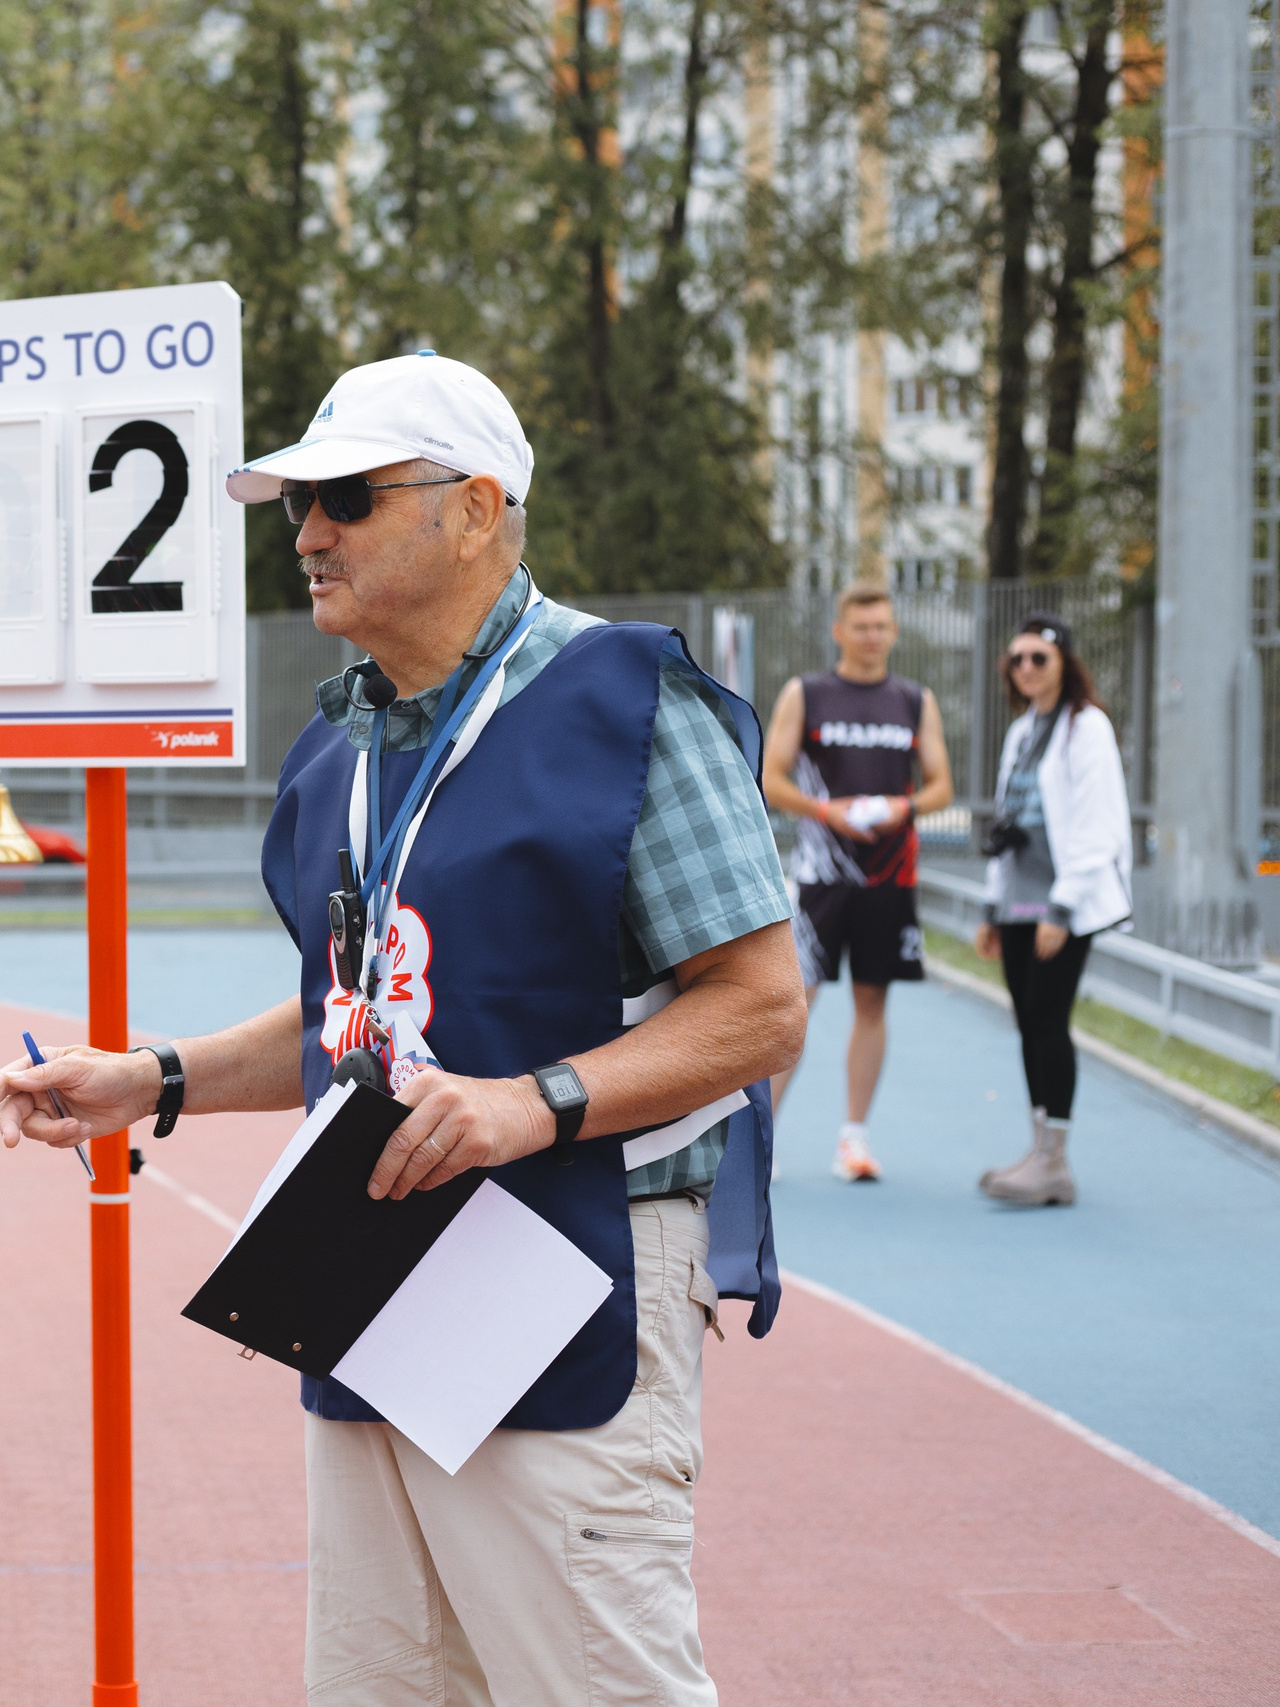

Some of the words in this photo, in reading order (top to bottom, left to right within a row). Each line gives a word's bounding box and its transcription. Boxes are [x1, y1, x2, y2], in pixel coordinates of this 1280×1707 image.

[64, 329, 126, 377] TO
[146, 320, 215, 371] GO
[424, 436, 454, 451] climalite
[88, 419, 189, 614] 2
[170, 731, 219, 750] polanik
